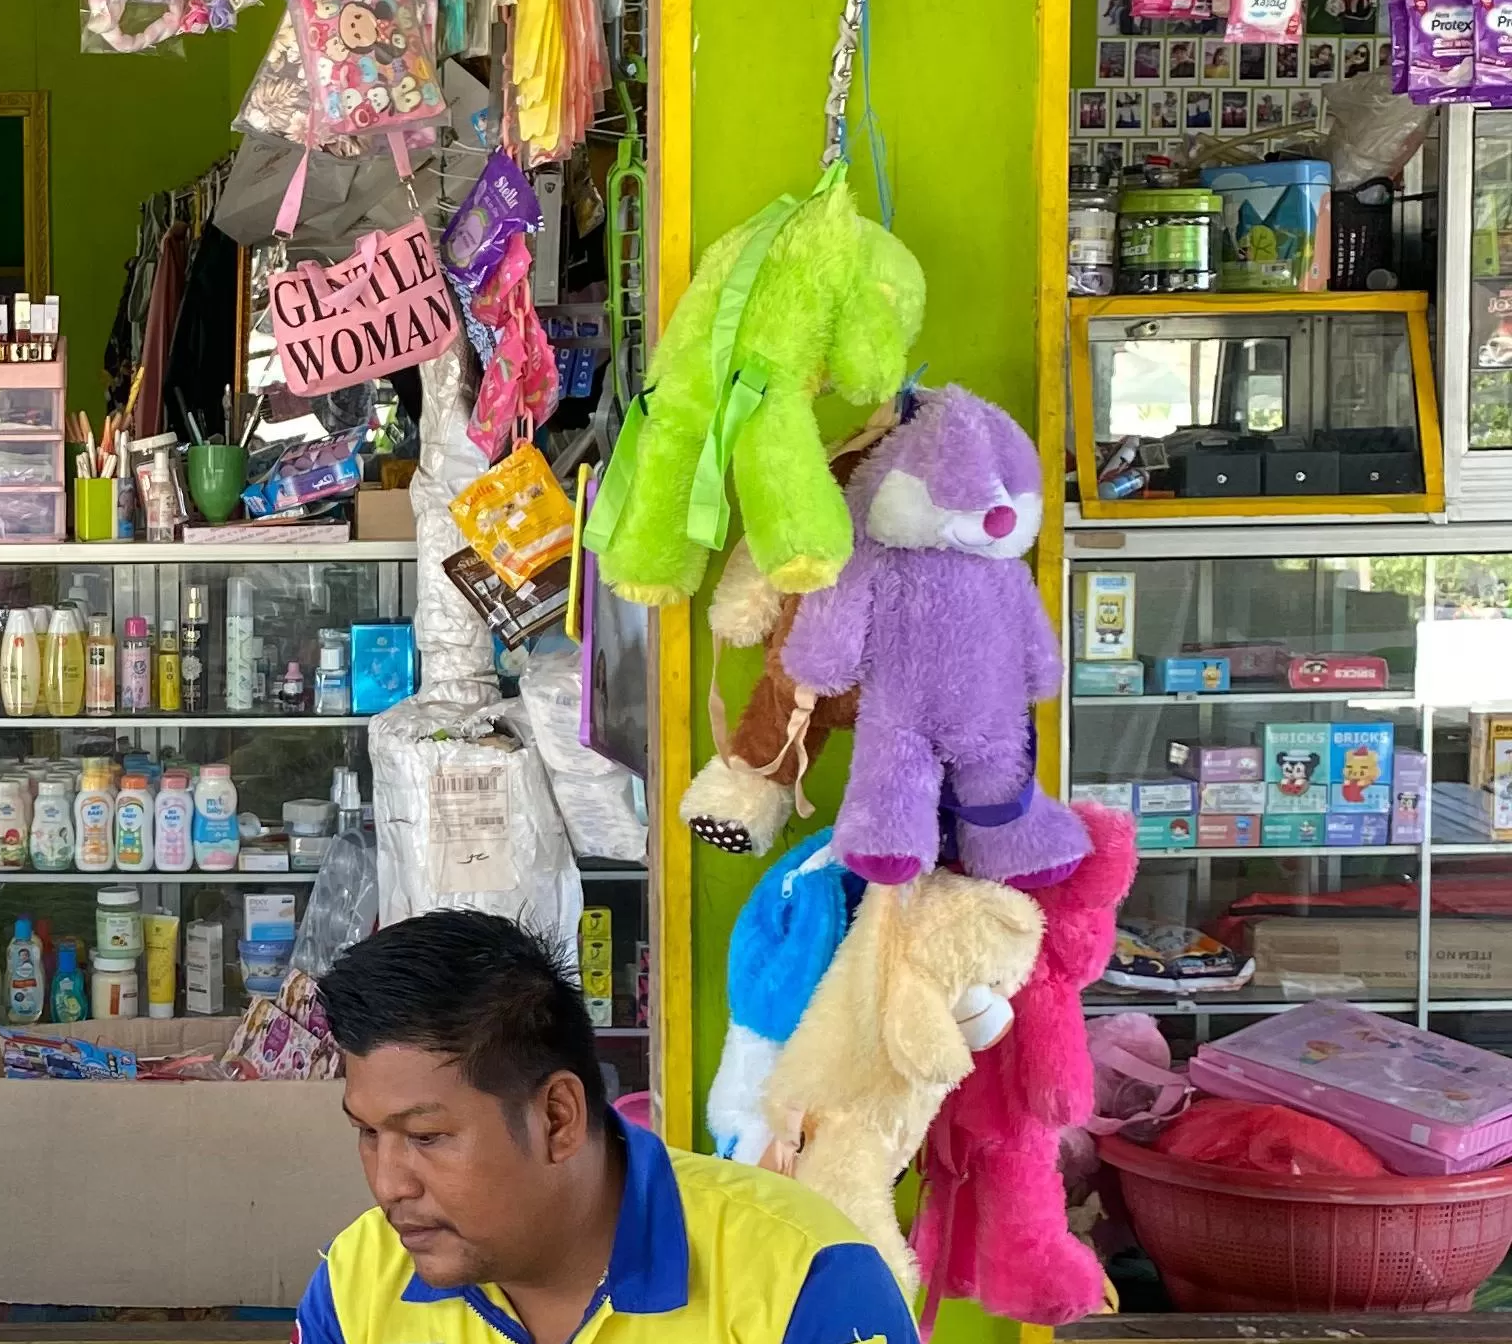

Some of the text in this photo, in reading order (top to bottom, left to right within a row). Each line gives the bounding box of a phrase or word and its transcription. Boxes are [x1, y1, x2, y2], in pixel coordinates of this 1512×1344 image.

[1431, 19, 1474, 33] Protex
[285, 288, 453, 385] WOMAN
[1271, 731, 1326, 744] BRICKS
[1333, 731, 1391, 745] BRICKS
